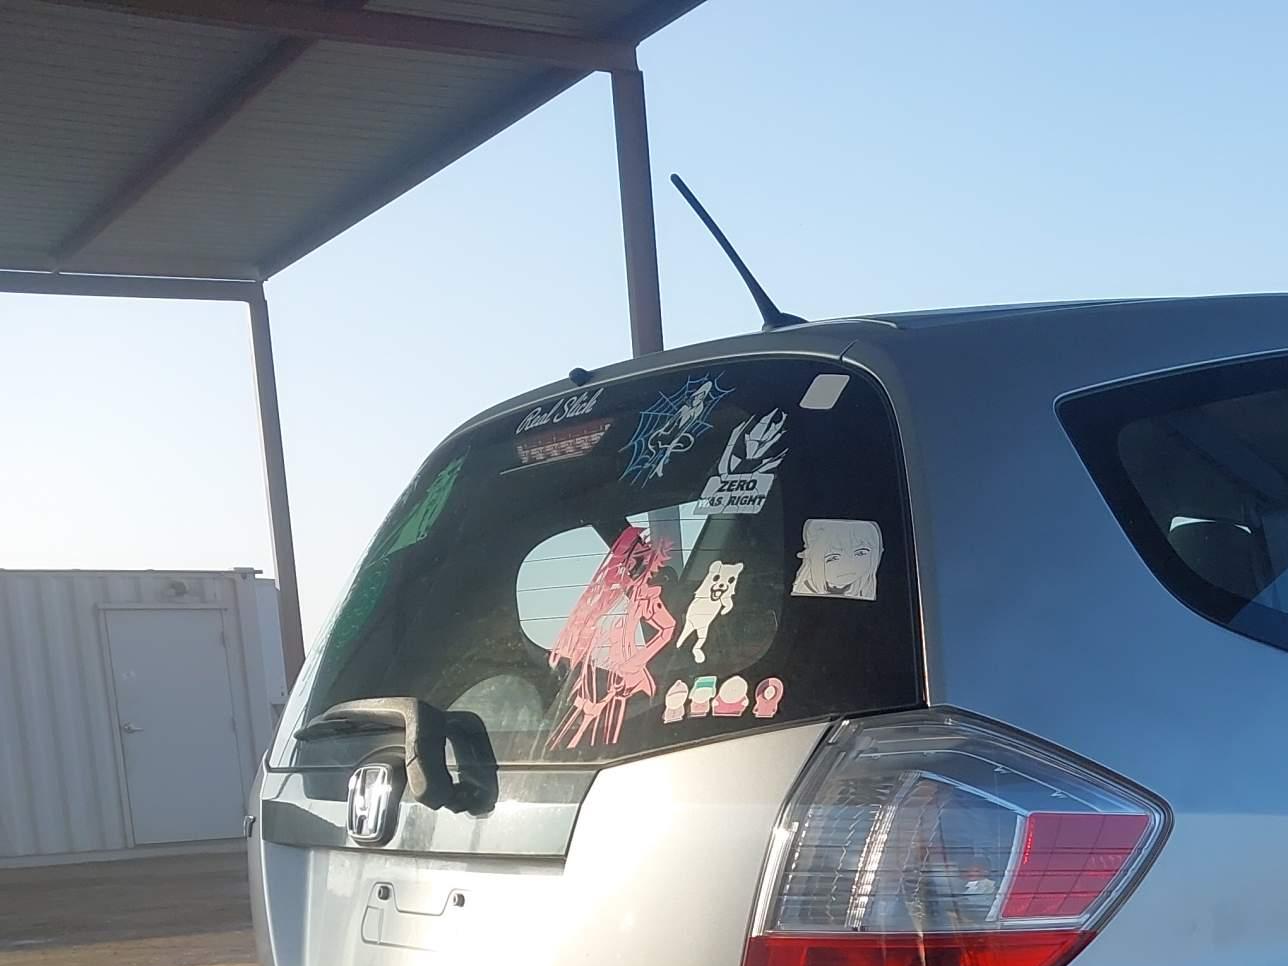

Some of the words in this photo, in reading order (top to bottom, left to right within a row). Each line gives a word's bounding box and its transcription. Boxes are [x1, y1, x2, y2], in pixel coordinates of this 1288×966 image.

[515, 398, 565, 435] Real
[717, 479, 758, 493] ZERO
[726, 494, 766, 506] RIGHT
